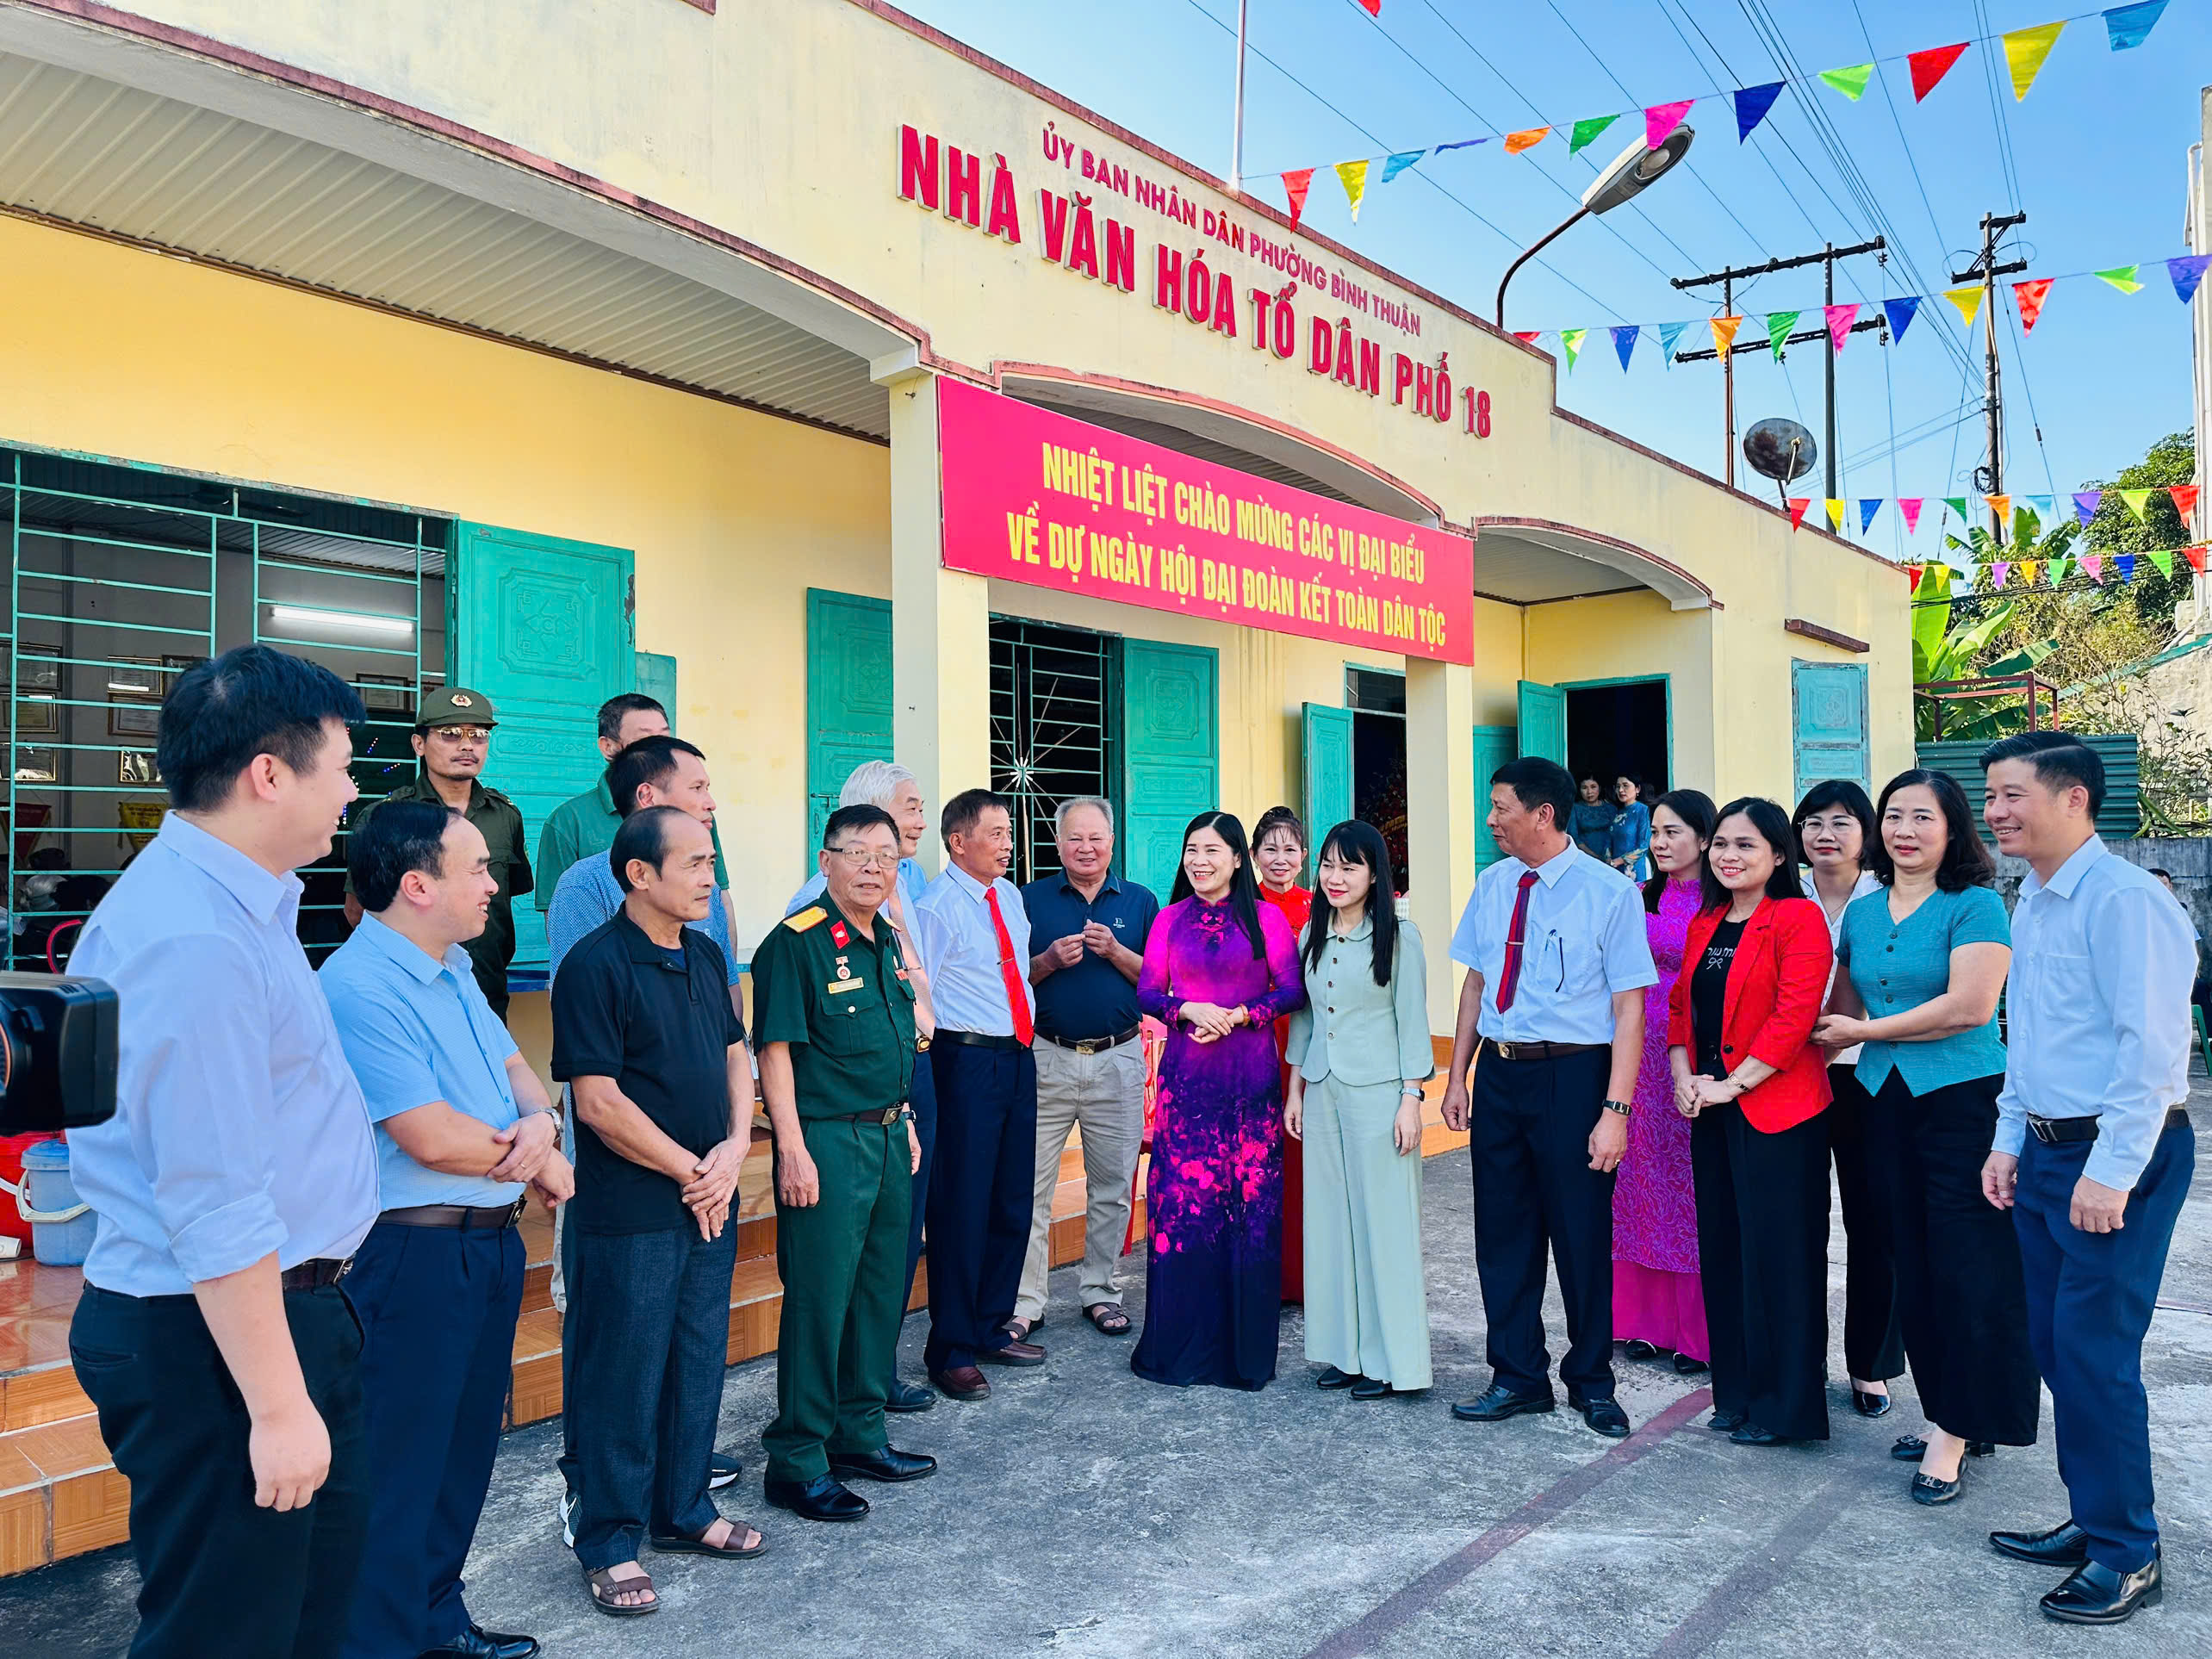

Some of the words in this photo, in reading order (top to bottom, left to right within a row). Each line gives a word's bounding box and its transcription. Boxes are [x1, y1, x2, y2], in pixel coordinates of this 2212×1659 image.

[897, 123, 1022, 245] NHÀ
[1035, 188, 1135, 294] VĂN
[1153, 243, 1237, 339] HÓA
[1247, 281, 1298, 359] TỔ
[1307, 315, 1380, 398] DÂN
[1391, 351, 1451, 423] PHỐ
[1460, 386, 1491, 439] 18
[1043, 121, 1075, 170] ỦY
[1082, 148, 1128, 197] BAN
[1135, 175, 1196, 230] NHÂN
[1203, 208, 1245, 253] DÂN
[1250, 233, 1327, 290] PHƯỜNG
[1331, 269, 1368, 313] BÌNH
[1372, 294, 1420, 337] THUẬN
[1006, 500, 1041, 565] VỀ
[1048, 521, 1085, 583] DỰ
[1090, 531, 1153, 588] NGÀY
[1160, 544, 1196, 605] HỘI
[1202, 558, 1237, 613] ĐẠI
[1242, 565, 1295, 618] ĐOÀN
[1299, 571, 1331, 624] KẾT
[1335, 586, 1379, 634] TOÀN
[1382, 594, 1415, 641] DÂN
[1418, 602, 1446, 652] TỘC
[1042, 442, 1115, 513] NHIỆT
[1122, 463, 1167, 526] LIỆT
[1174, 480, 1231, 536] CHÀO
[1236, 494, 1294, 552] MỪNG
[1298, 513, 1334, 562] CÁC
[1338, 527, 1355, 576] VỊ
[1358, 533, 1386, 581] ĐẠI
[1390, 532, 1425, 585] BIỂU
